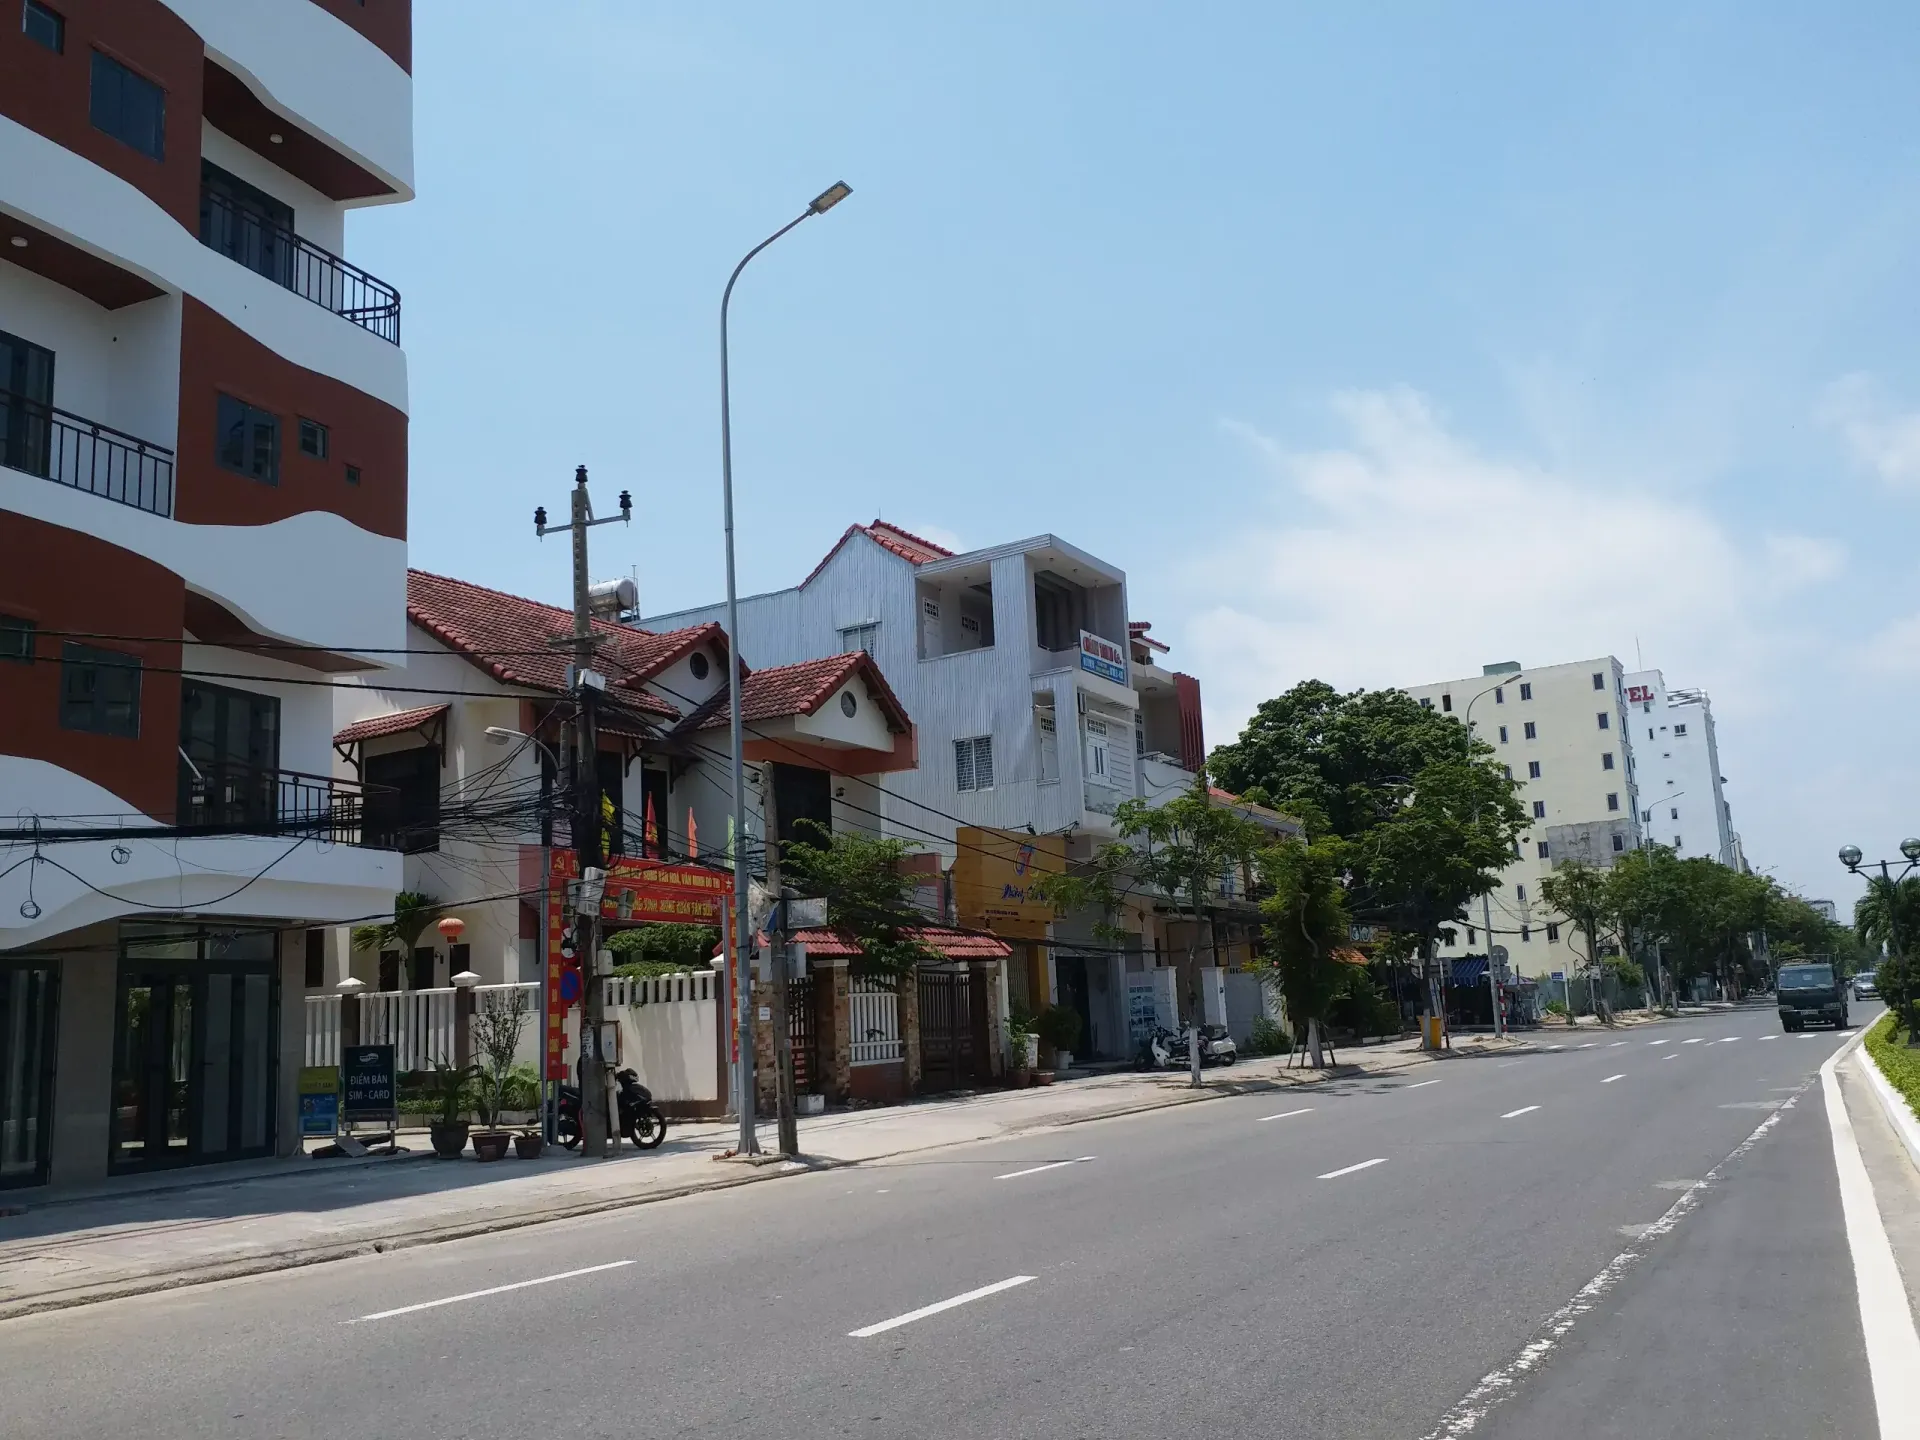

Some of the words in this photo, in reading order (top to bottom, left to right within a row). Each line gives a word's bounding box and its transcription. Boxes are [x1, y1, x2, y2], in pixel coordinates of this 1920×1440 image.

[1624, 686, 1654, 702] EL
[350, 1072, 371, 1085] ĐIỂM
[371, 1073, 388, 1084] BÁN
[348, 1090, 363, 1100] SIM
[368, 1089, 390, 1100] CARD
